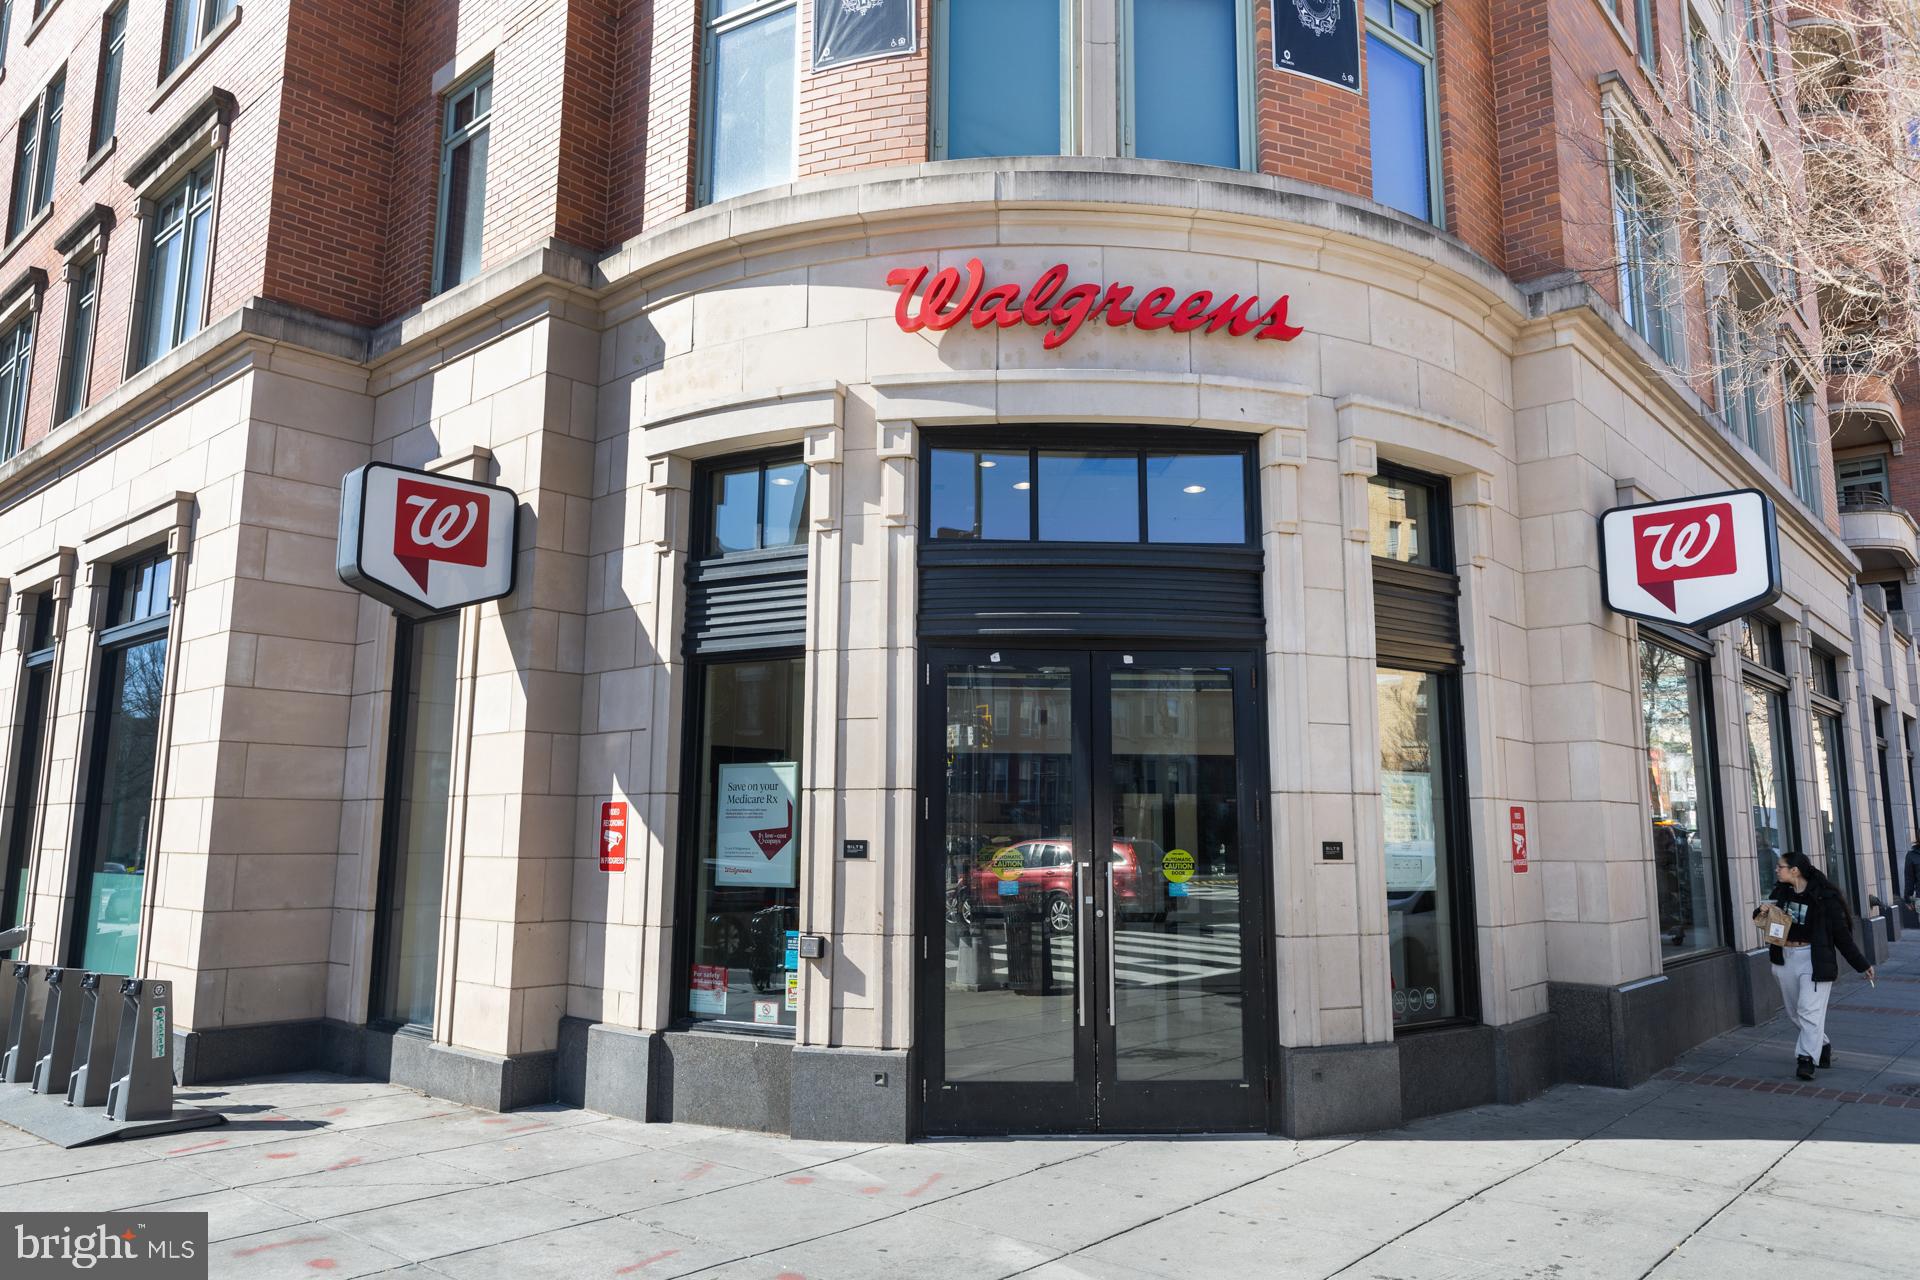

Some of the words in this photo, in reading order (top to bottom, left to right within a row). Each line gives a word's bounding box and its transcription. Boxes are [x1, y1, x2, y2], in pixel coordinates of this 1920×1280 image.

[886, 257, 1304, 350] Walgreens
[405, 495, 479, 549] W
[1642, 513, 1721, 571] W
[727, 782, 746, 792] Save
[747, 783, 758, 791] on
[759, 783, 779, 793] your
[727, 794, 765, 804] Medicare
[766, 794, 778, 804] Rx
